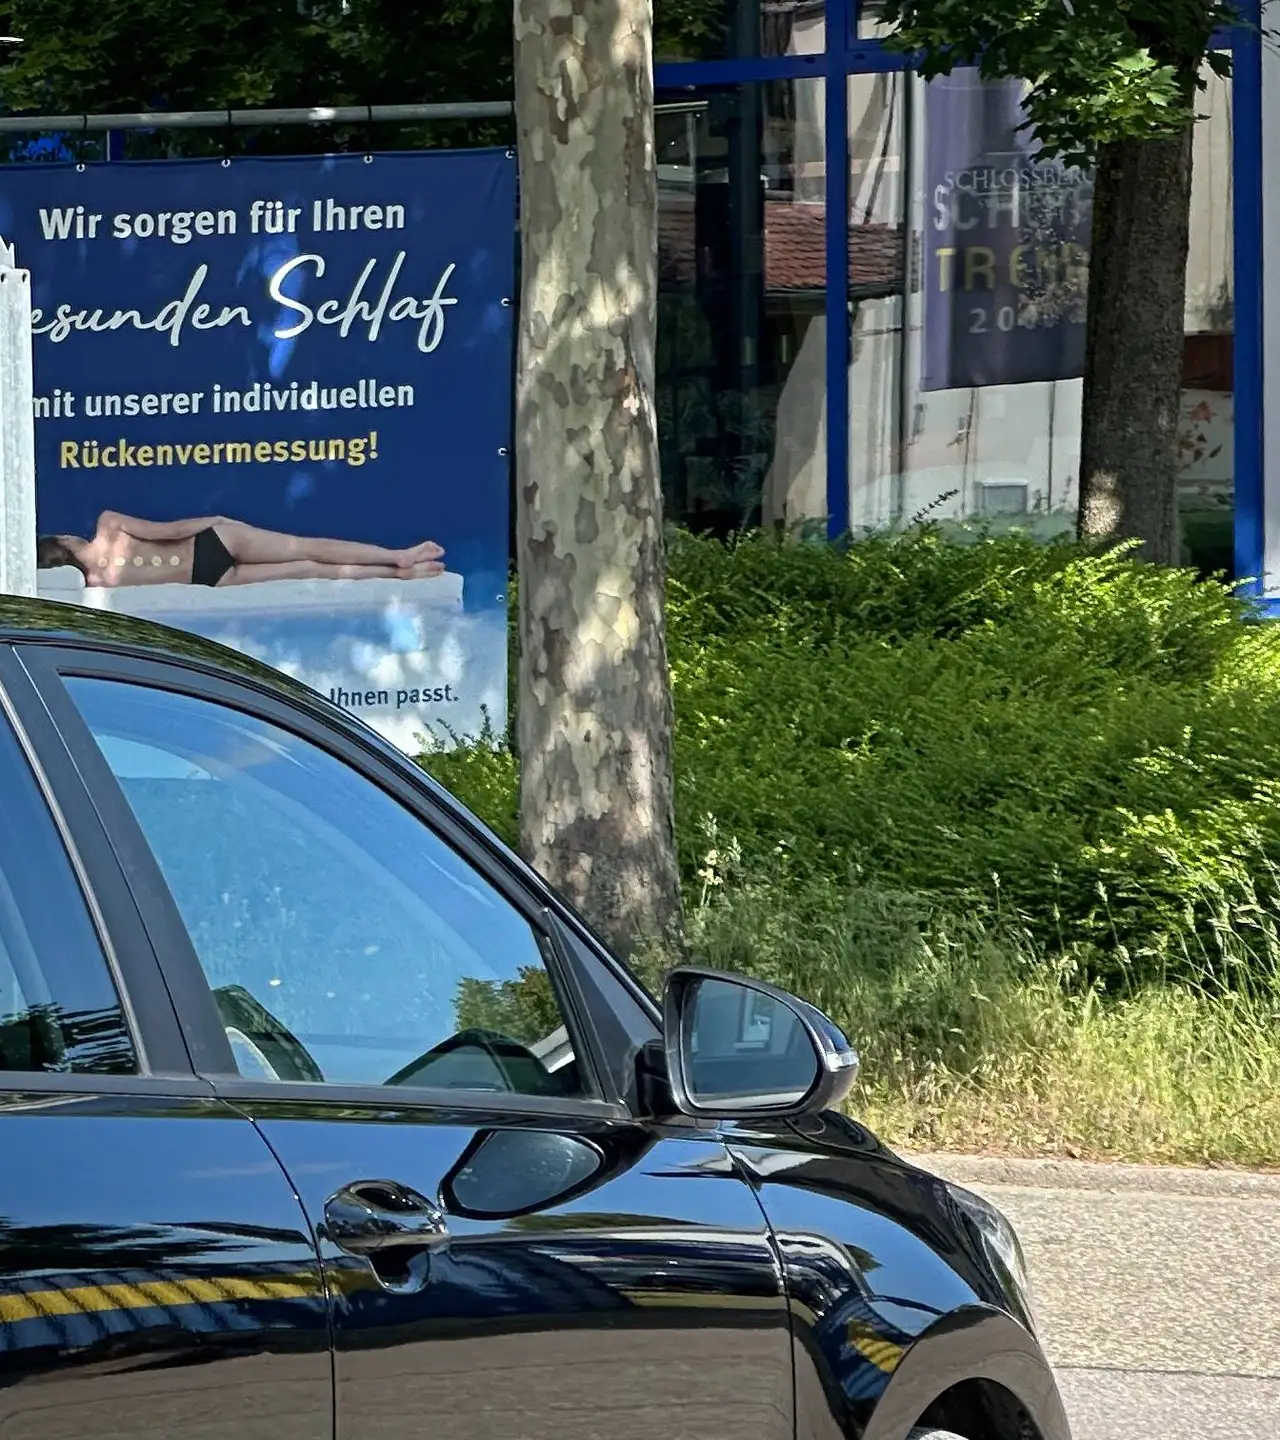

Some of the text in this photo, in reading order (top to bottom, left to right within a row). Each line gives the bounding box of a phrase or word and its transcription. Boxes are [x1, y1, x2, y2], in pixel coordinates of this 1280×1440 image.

[39, 199, 405, 244] Wir sorgen für Ihren
[31, 250, 458, 353] esunden Schlaf
[32, 379, 415, 418] mit unserer individuellen
[60, 431, 380, 470] Rückenvermessung!
[329, 683, 460, 709] Ihnen passt.
